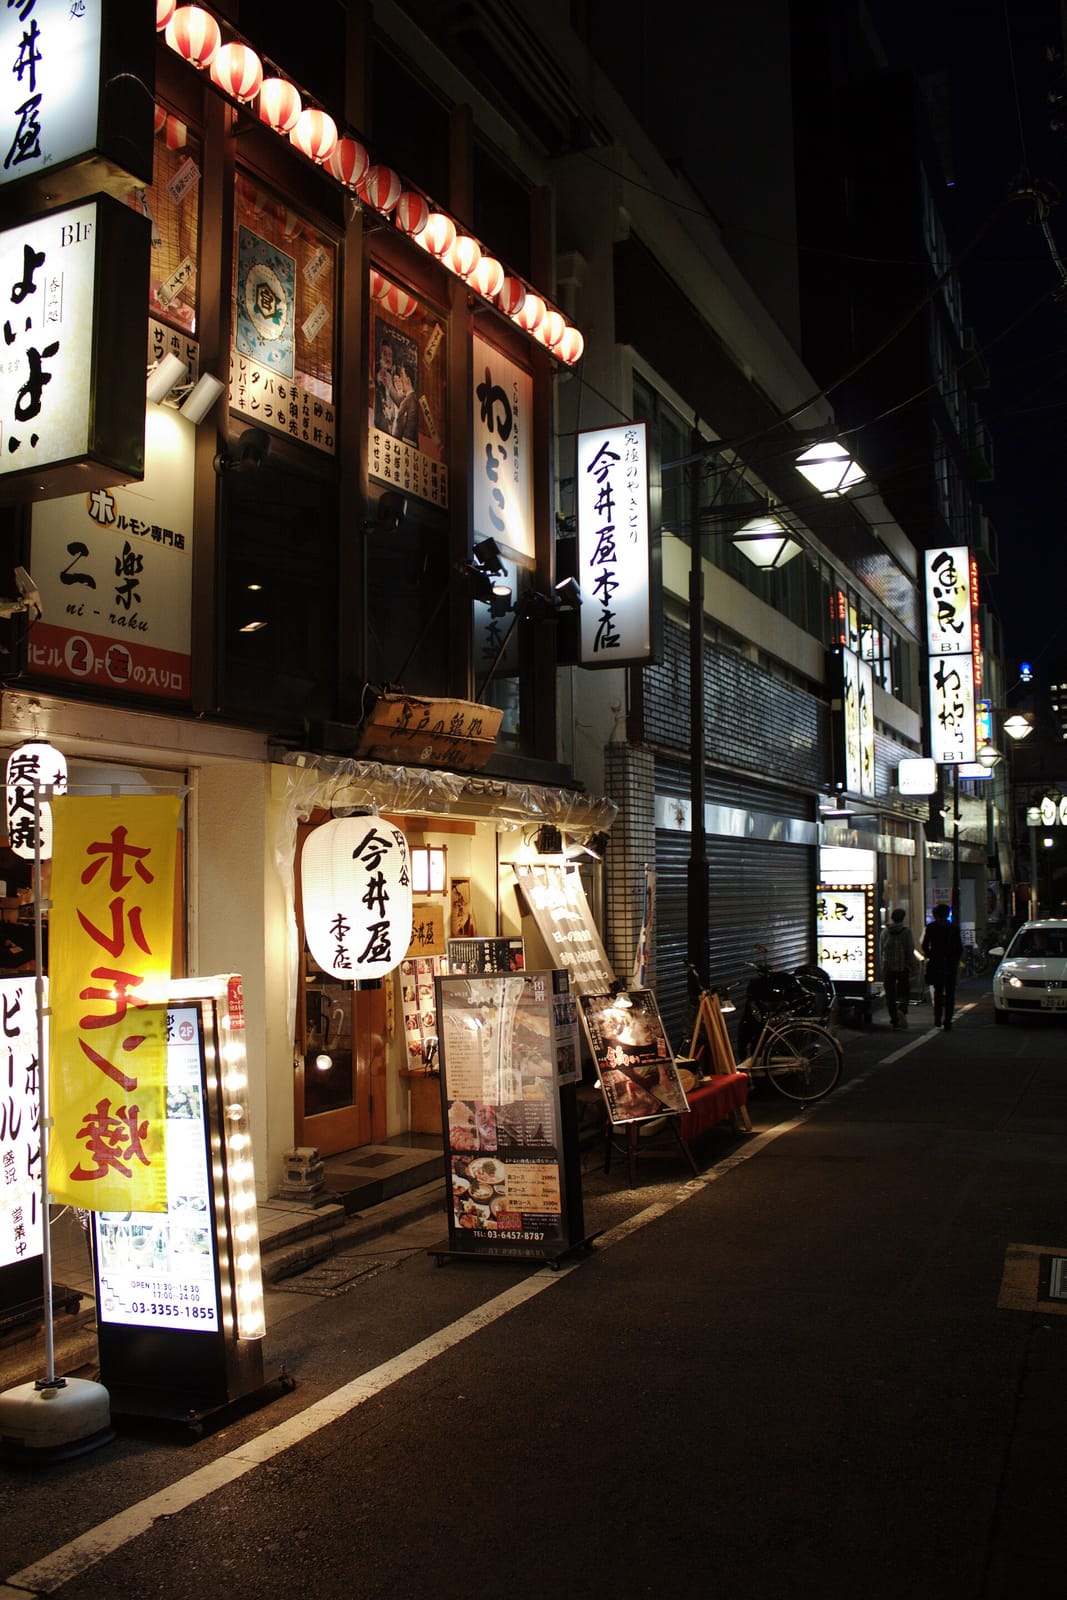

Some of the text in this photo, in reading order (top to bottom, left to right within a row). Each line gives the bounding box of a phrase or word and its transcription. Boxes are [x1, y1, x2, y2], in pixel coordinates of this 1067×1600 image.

[61, 222, 92, 248] B1F
[4, 244, 60, 454] よいよい
[263, 377, 274, 417] バラ
[277, 384, 287, 424] もも
[288, 386, 299, 436] 手羽先
[88, 489, 185, 550] ホルモン専門店
[587, 440, 621, 652] 今井屋本店
[60, 541, 144, 610] 二楽
[931, 551, 965, 634] 魚民
[941, 643, 960, 652] B1
[943, 751, 964, 761] B1
[352, 828, 393, 964] 今井屋
[329, 913, 353, 970] 本店
[179, 1026, 193, 1038] 2F
[0, 986, 23, 1142] ビール
